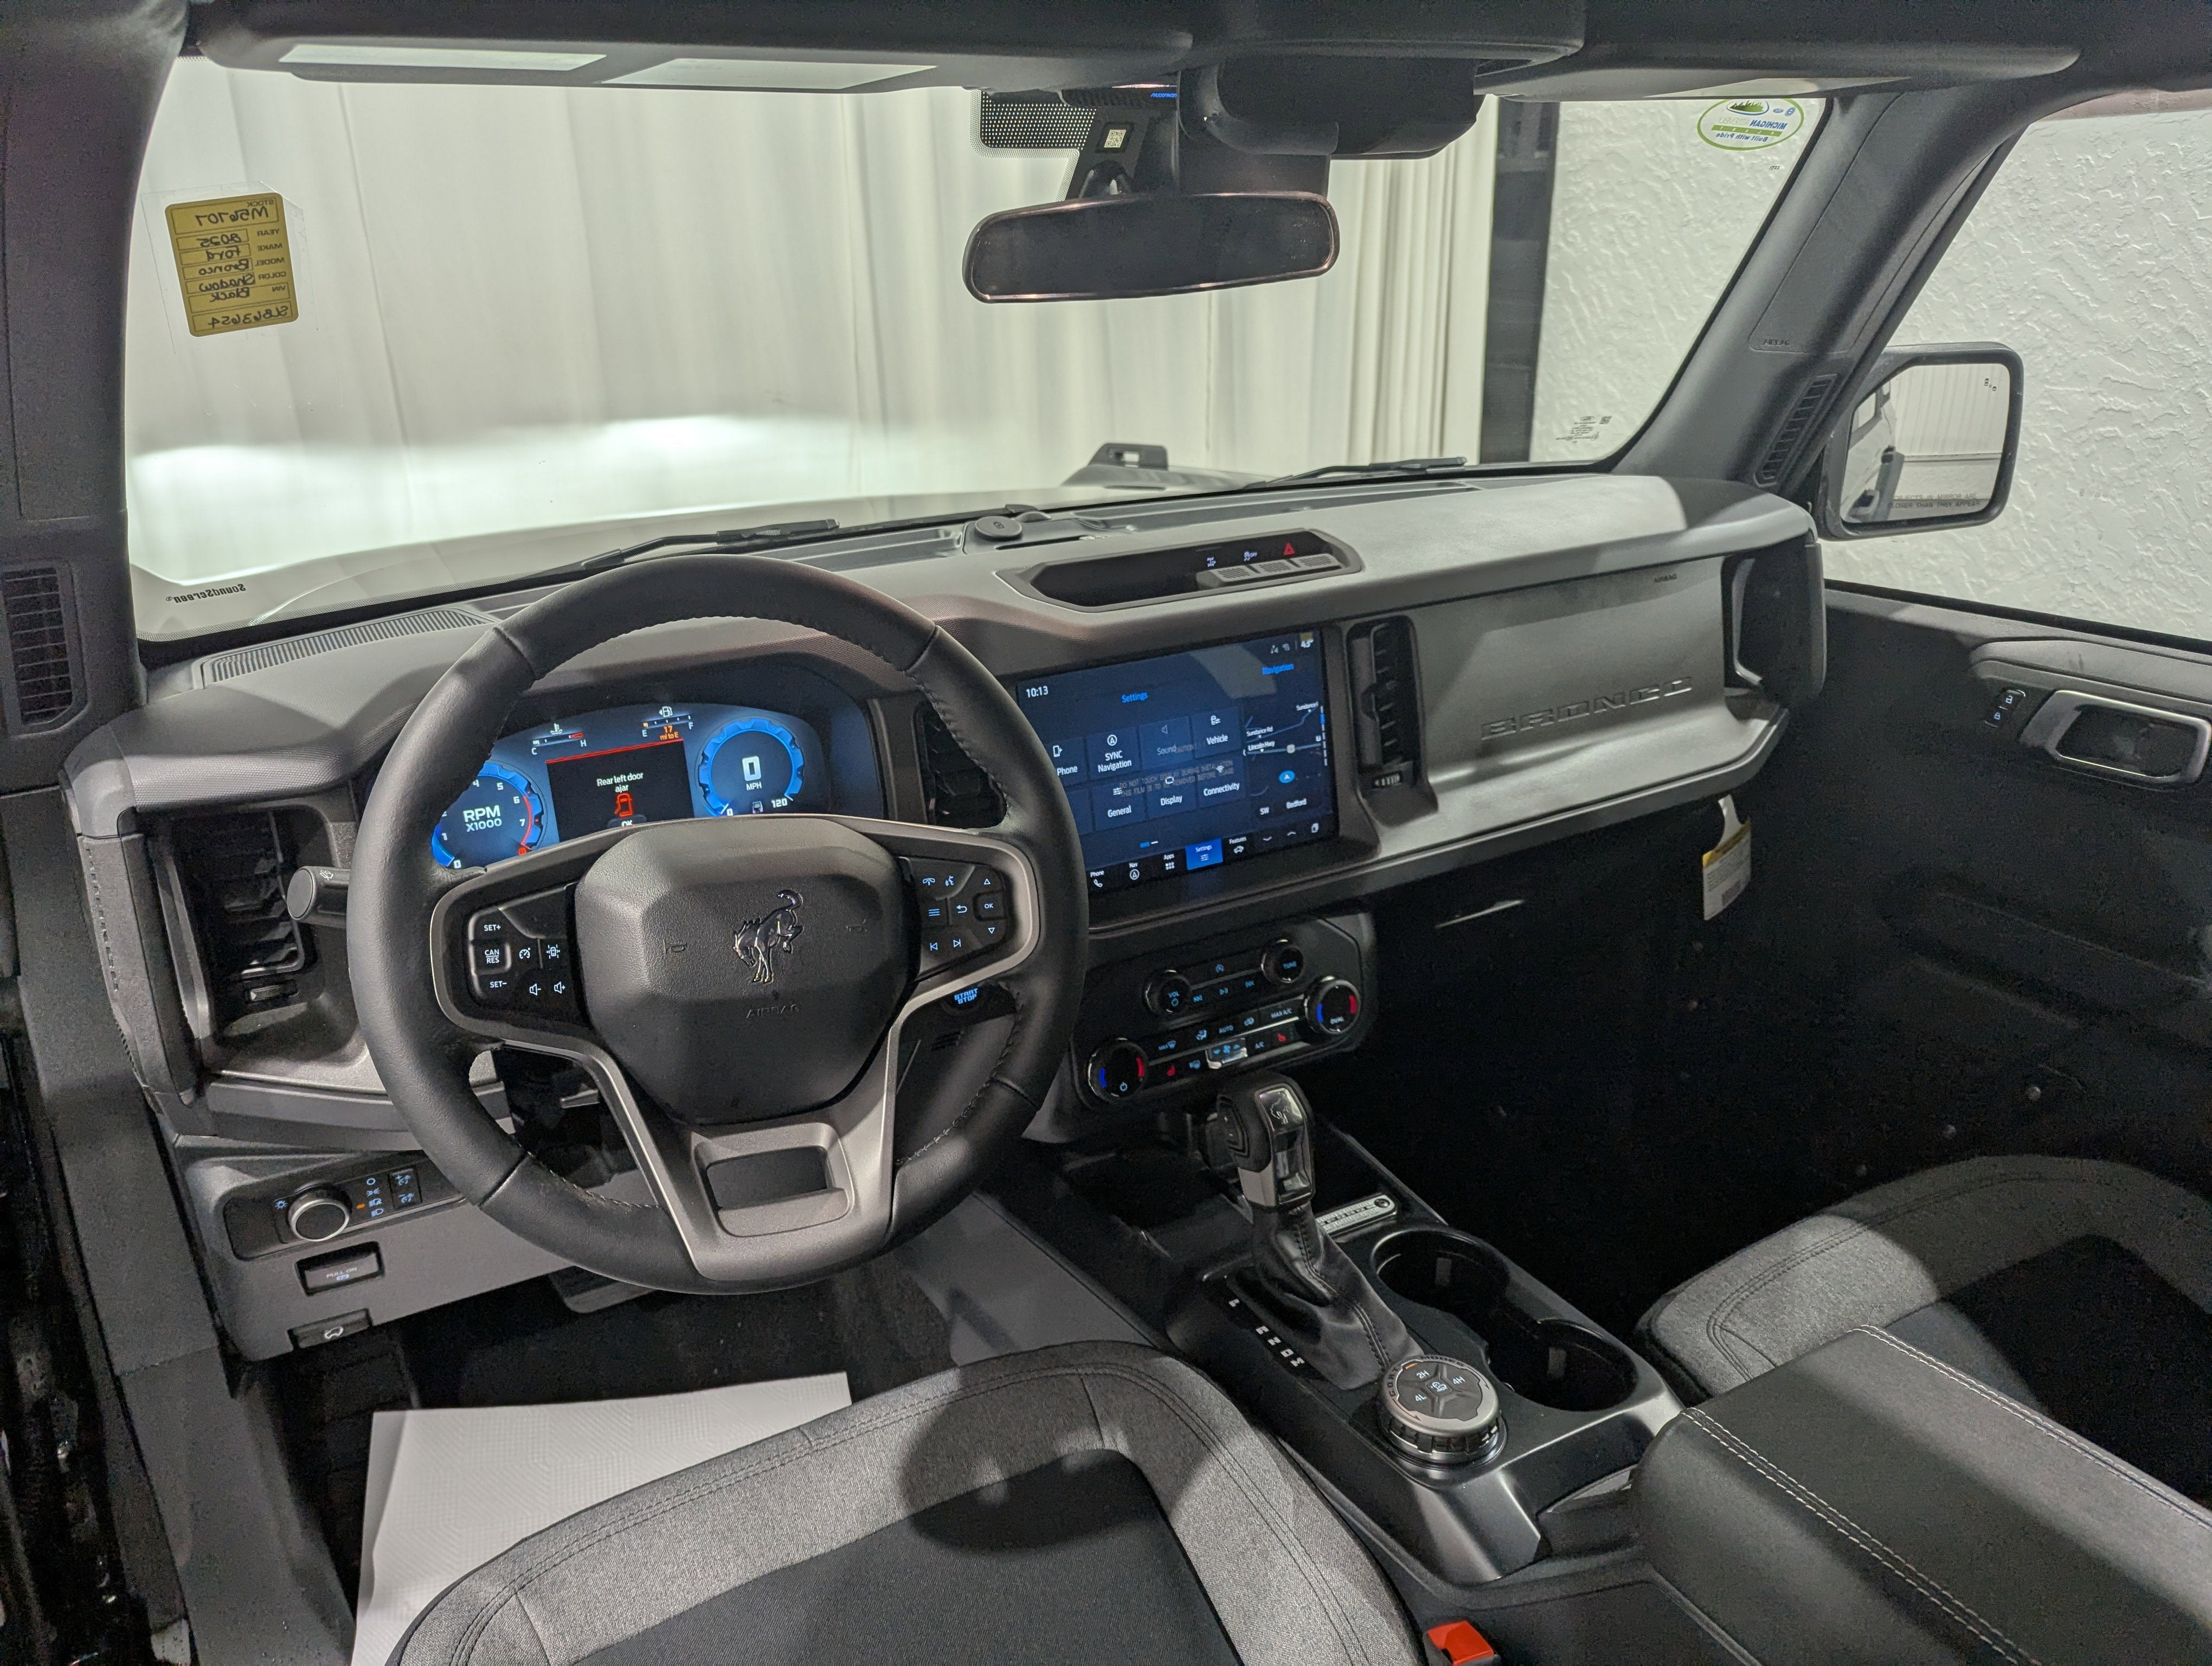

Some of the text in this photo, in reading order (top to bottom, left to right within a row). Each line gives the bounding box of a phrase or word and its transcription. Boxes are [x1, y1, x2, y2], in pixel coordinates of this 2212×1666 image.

[1262, 664, 1294, 675] Navigation
[1026, 685, 1049, 698] 10:13
[1121, 691, 1148, 703] Settings
[663, 725, 673, 733] 17
[689, 722, 693, 730] F
[642, 729, 648, 738] E
[1206, 735, 1228, 745] Vehicle
[531, 747, 538, 755] C
[1157, 743, 1176, 755] Sound
[1105, 750, 1123, 761] SYNC
[742, 755, 762, 781] 0
[1057, 766, 1078, 776] Phone
[1097, 760, 1132, 773] Navigation
[596, 772, 644, 787] Rear left door
[497, 782, 504, 791] 5
[615, 784, 629, 793] ajar
[746, 781, 762, 791] MPH
[1203, 782, 1240, 797] Connectivity
[513, 796, 520, 804] 6
[771, 798, 788, 808] 120
[1160, 795, 1183, 806] Display
[463, 805, 501, 823] RPM
[1107, 805, 1132, 818] General
[1259, 806, 1270, 815] SW
[466, 818, 502, 832] X1000
[519, 819, 526, 827] 7
[1229, 836, 1247, 844] Features
[1195, 844, 1213, 853] Settings
[454, 860, 462, 869] 0
[954, 988, 979, 1001] START
[957, 994, 978, 1004] STOP
[1219, 1025, 1234, 1034] AUTO
[1268, 1337, 1281, 1345] N
[1281, 1349, 1294, 1357] D
[1416, 1370, 1429, 1379] 2H
[1452, 1376, 1465, 1385] 4H
[1415, 1394, 1427, 1402] 4L
